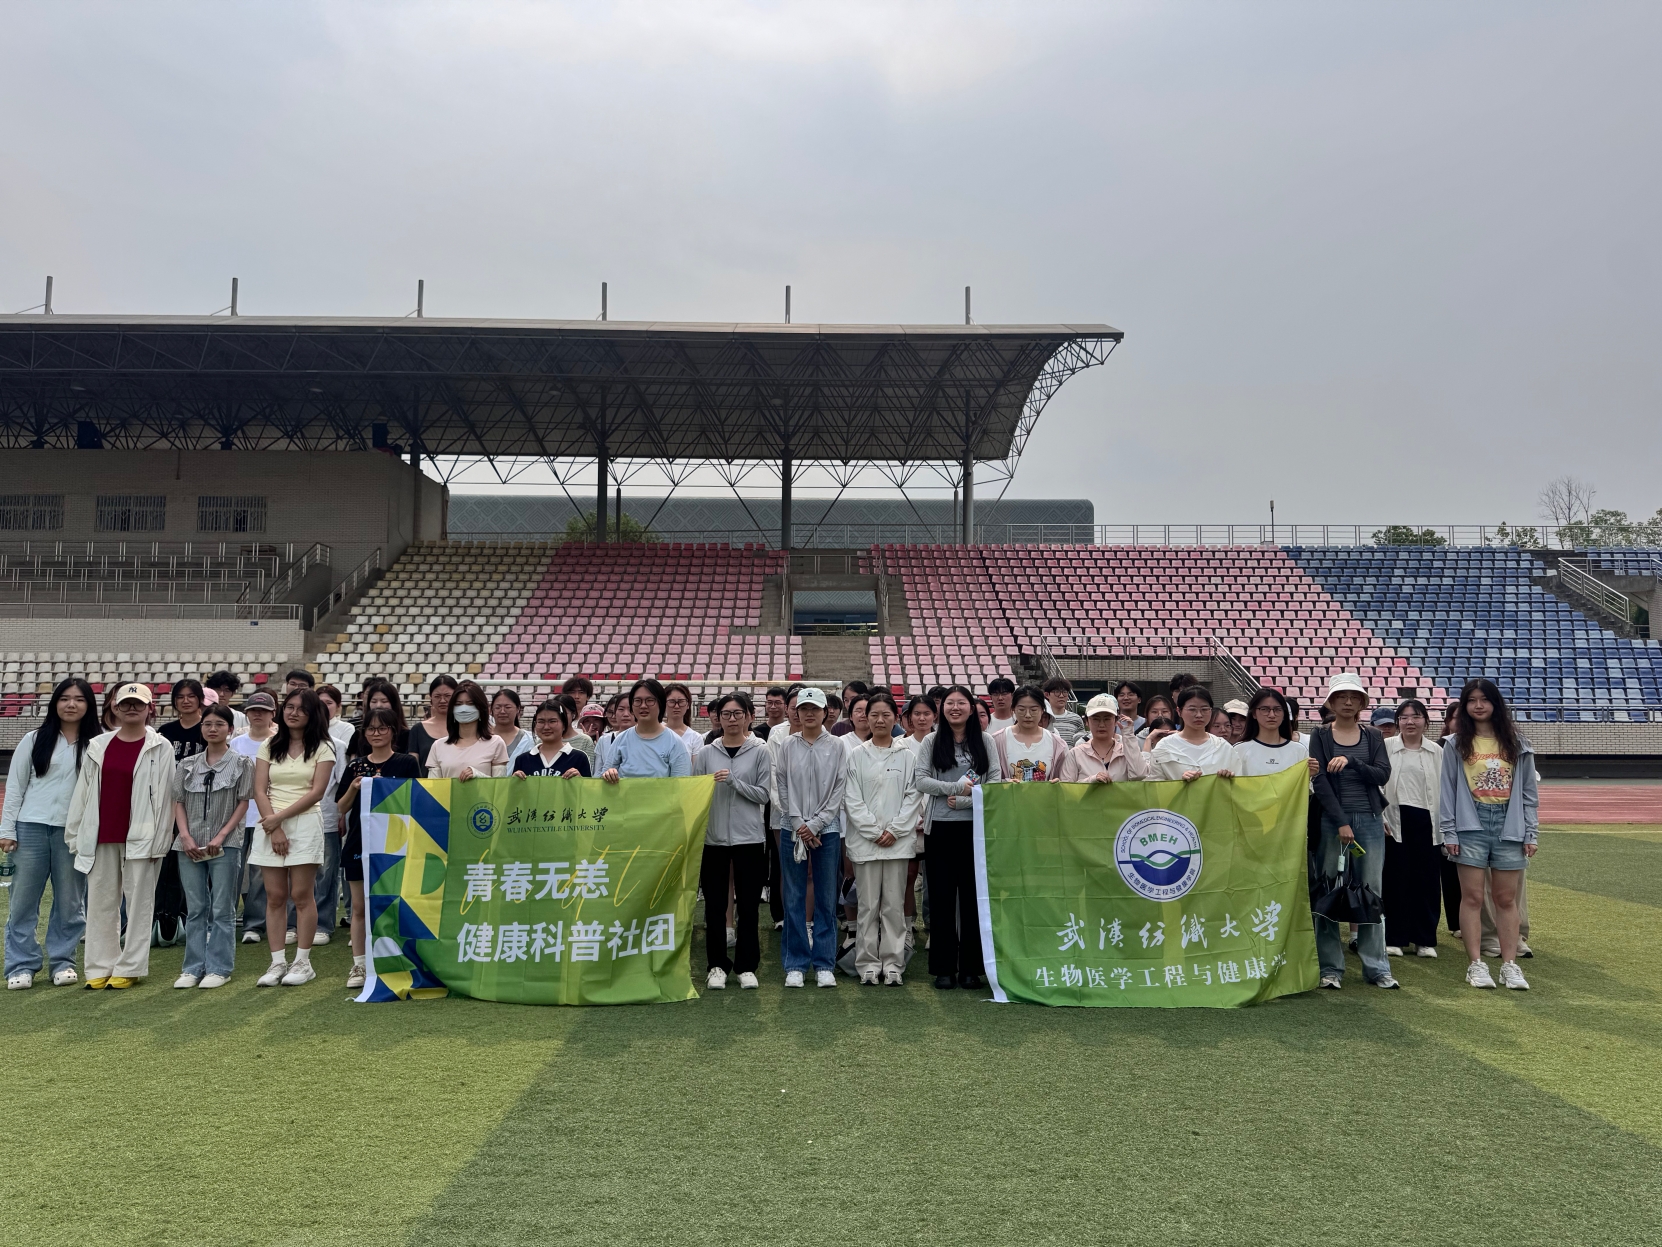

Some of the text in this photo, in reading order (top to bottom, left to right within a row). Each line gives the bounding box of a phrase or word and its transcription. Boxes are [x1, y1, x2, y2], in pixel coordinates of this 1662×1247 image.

[1140, 833, 1178, 847] BMEH
[463, 859, 610, 902] 青春无恙
[456, 913, 675, 963] 健康科普社团
